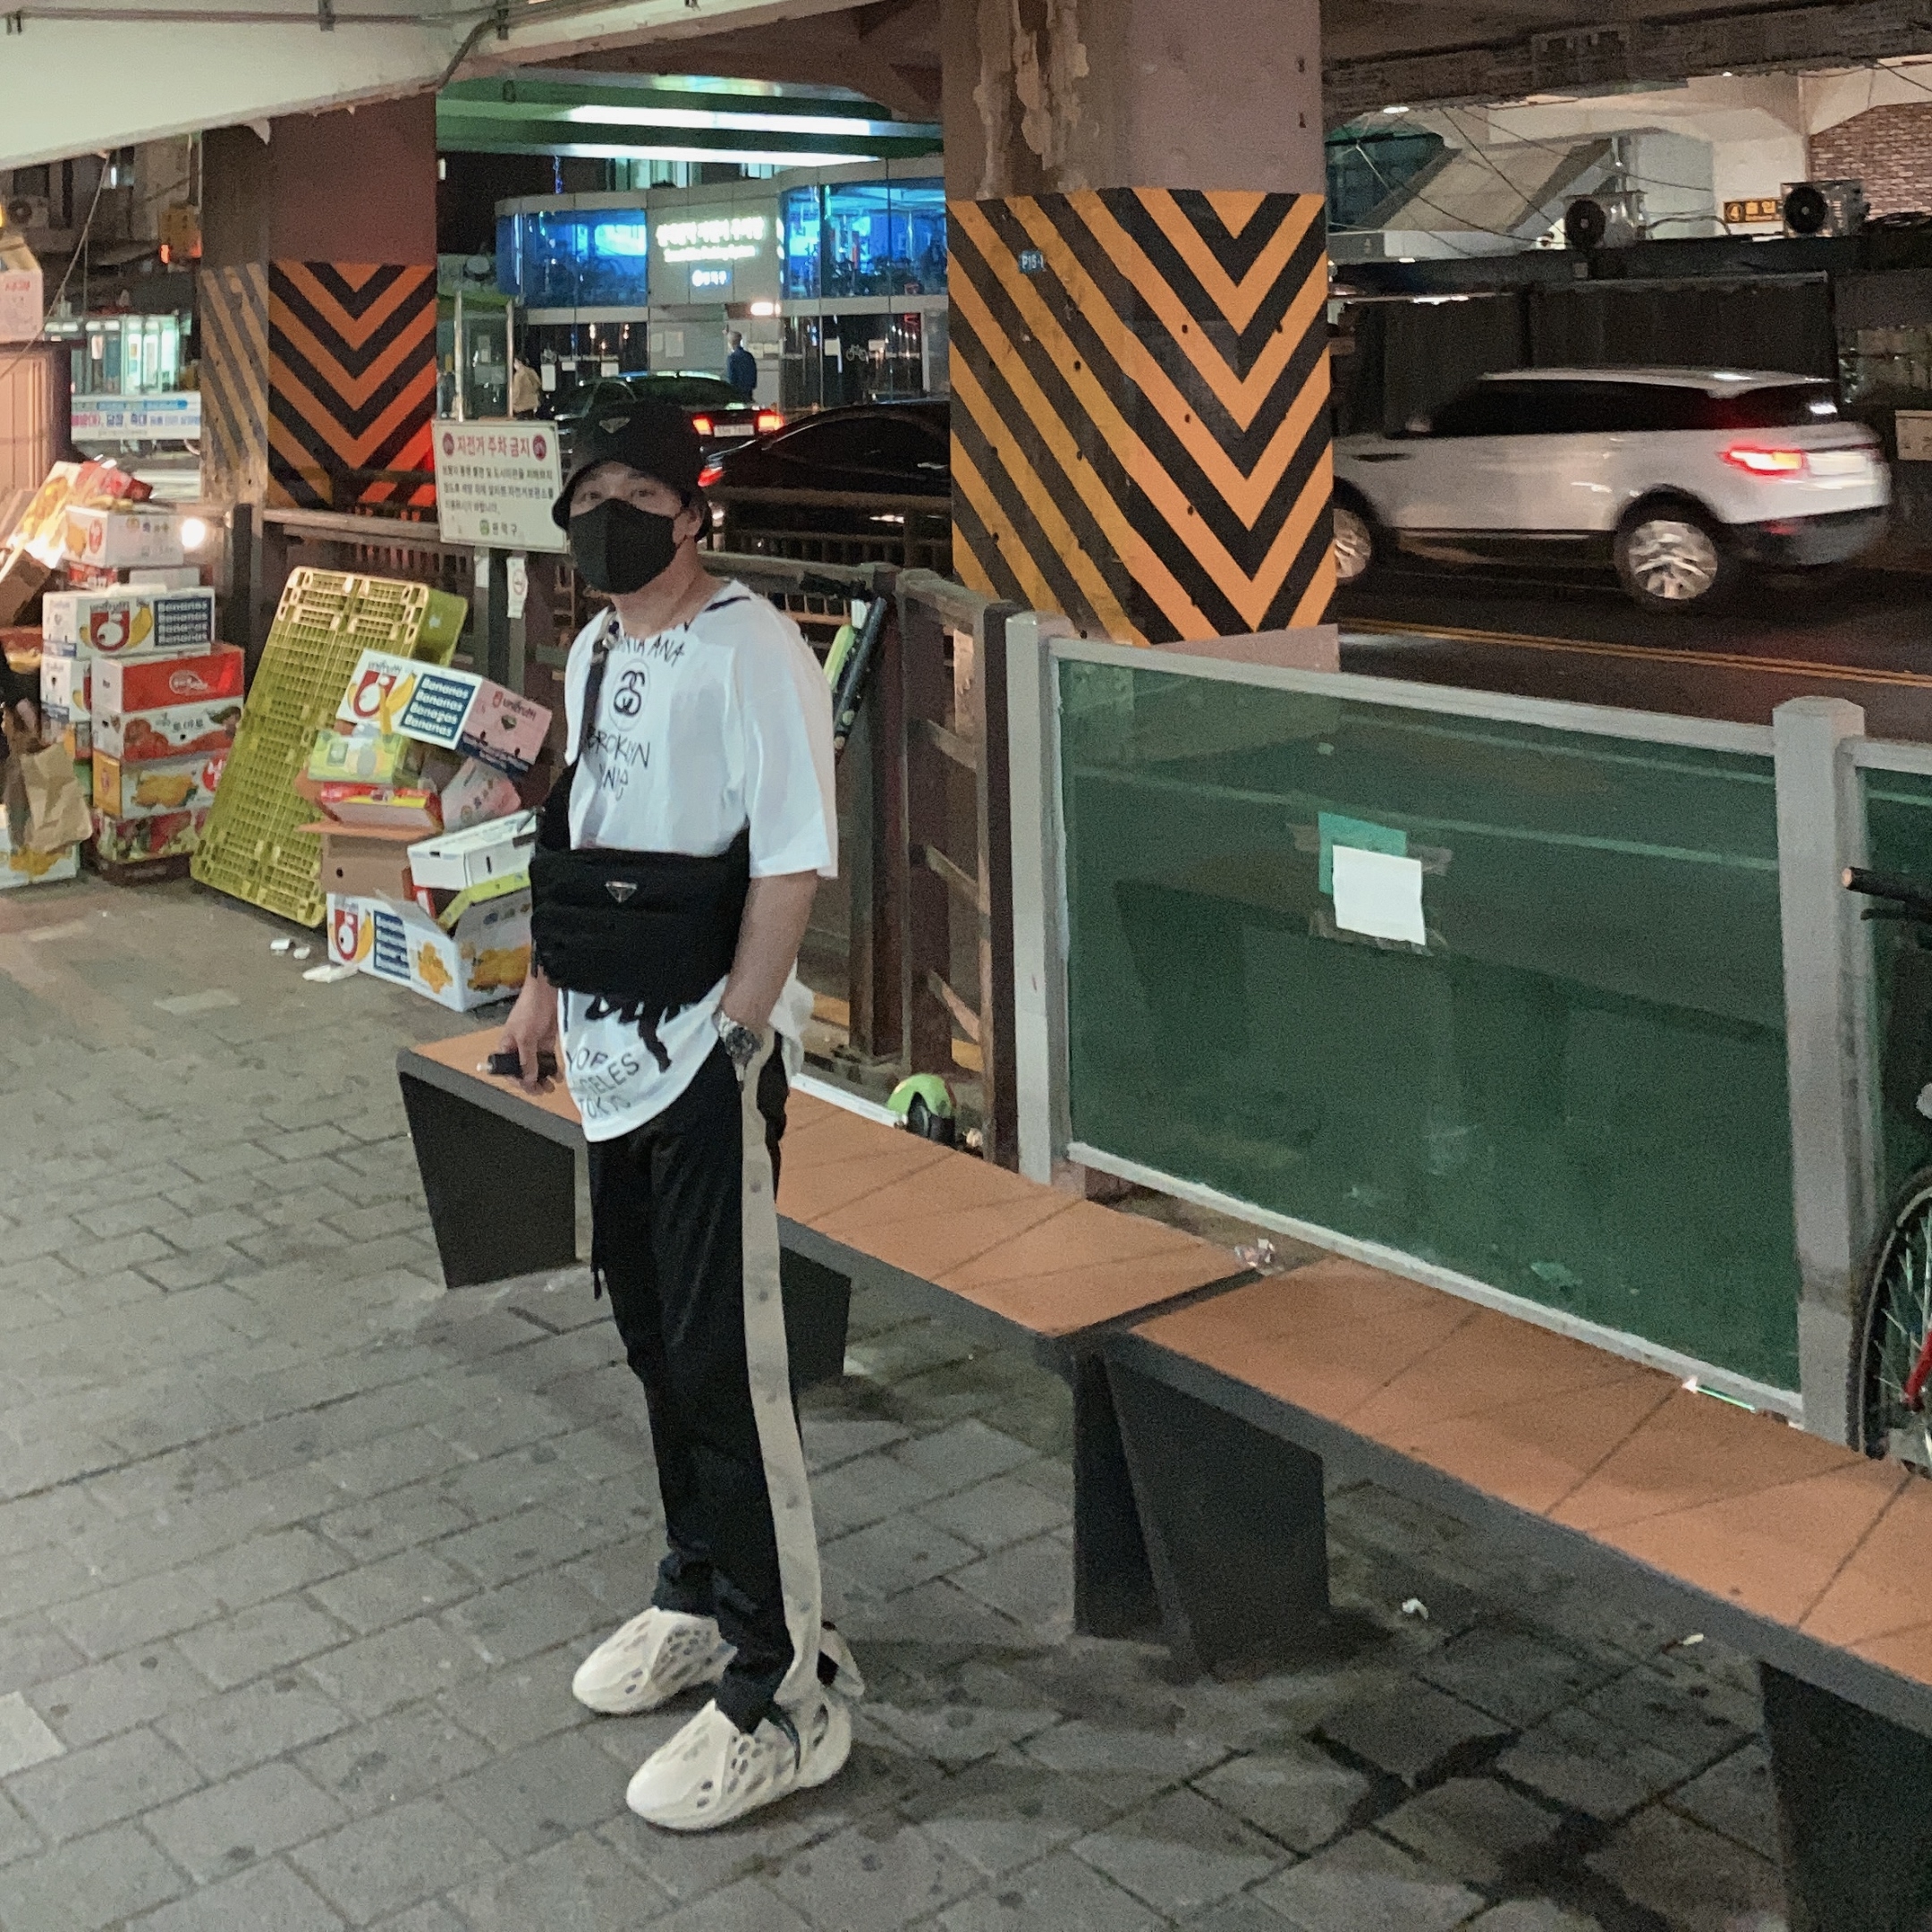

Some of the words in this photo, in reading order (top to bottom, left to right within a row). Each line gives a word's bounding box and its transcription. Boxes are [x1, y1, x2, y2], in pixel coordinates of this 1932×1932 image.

[457, 436, 485, 456] 자전거
[487, 436, 507, 457] 주차
[510, 436, 530, 458] 금지
[157, 600, 208, 613] Bananas
[421, 677, 470, 699] Bananas
[415, 690, 464, 712] Bananas
[404, 714, 453, 738] Bananas
